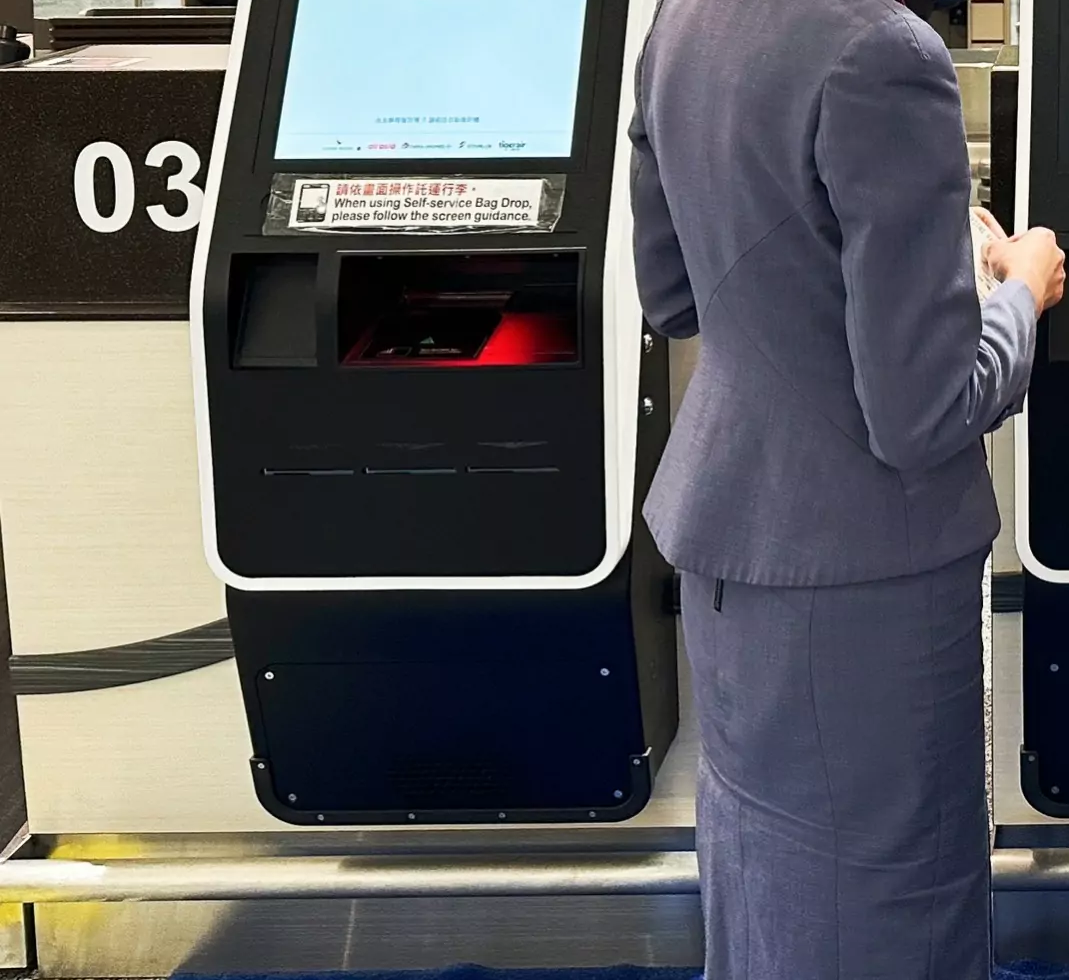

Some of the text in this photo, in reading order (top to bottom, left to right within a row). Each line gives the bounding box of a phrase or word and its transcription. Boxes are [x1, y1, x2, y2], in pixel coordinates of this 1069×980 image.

[74, 141, 204, 233] 03
[334, 197, 532, 210] When using Self-service Bag Drop,
[332, 210, 531, 223] please follow the screen guidance.
